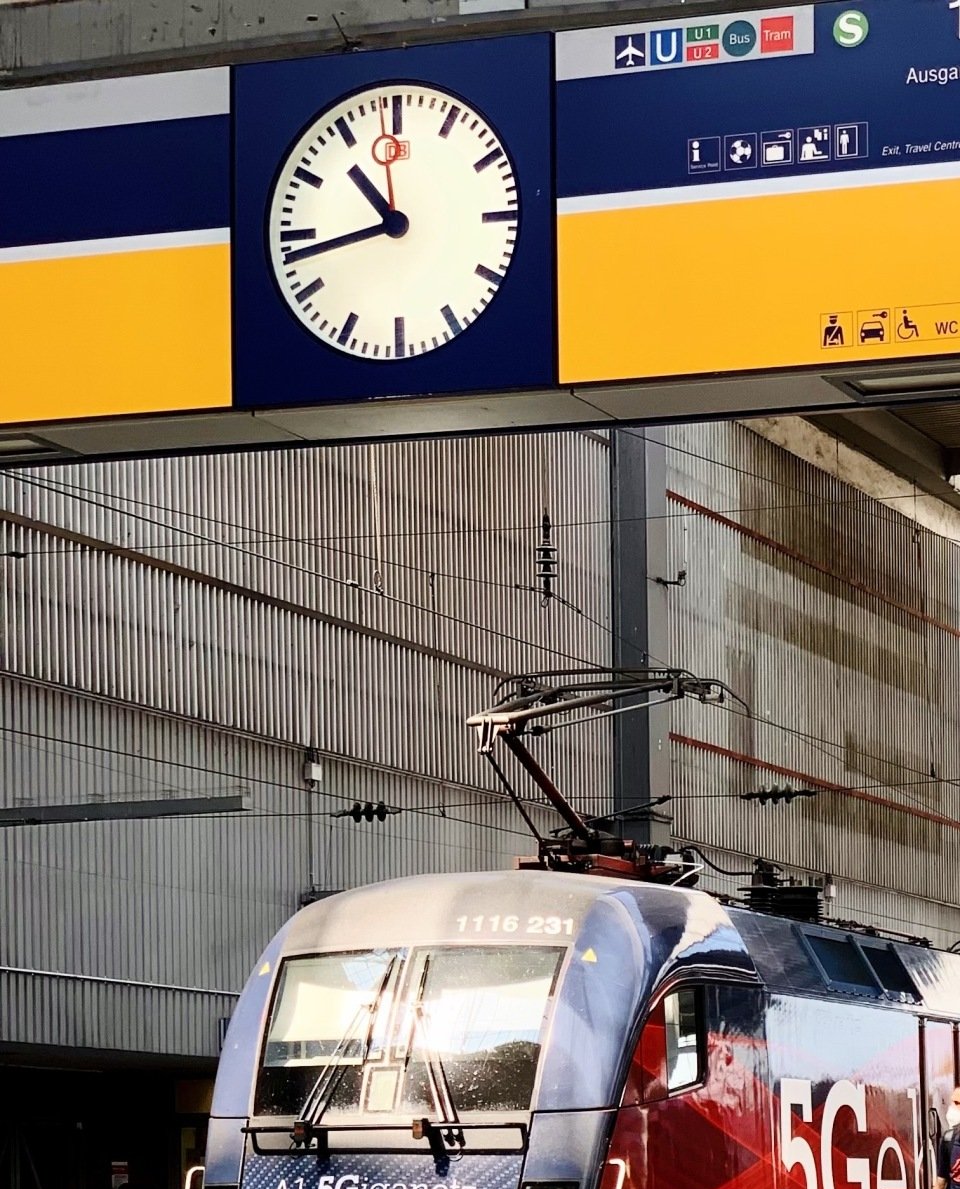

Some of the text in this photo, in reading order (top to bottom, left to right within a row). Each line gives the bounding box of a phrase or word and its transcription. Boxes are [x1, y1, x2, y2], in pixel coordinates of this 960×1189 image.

[763, 28, 791, 43] Tram
[838, 12, 864, 46] S
[655, 31, 677, 63] U
[729, 33, 750, 46] Bus
[881, 145, 902, 157] Exit,
[905, 142, 932, 154] Travel
[935, 321, 959, 336] WC
[456, 914, 574, 936] 1116 231
